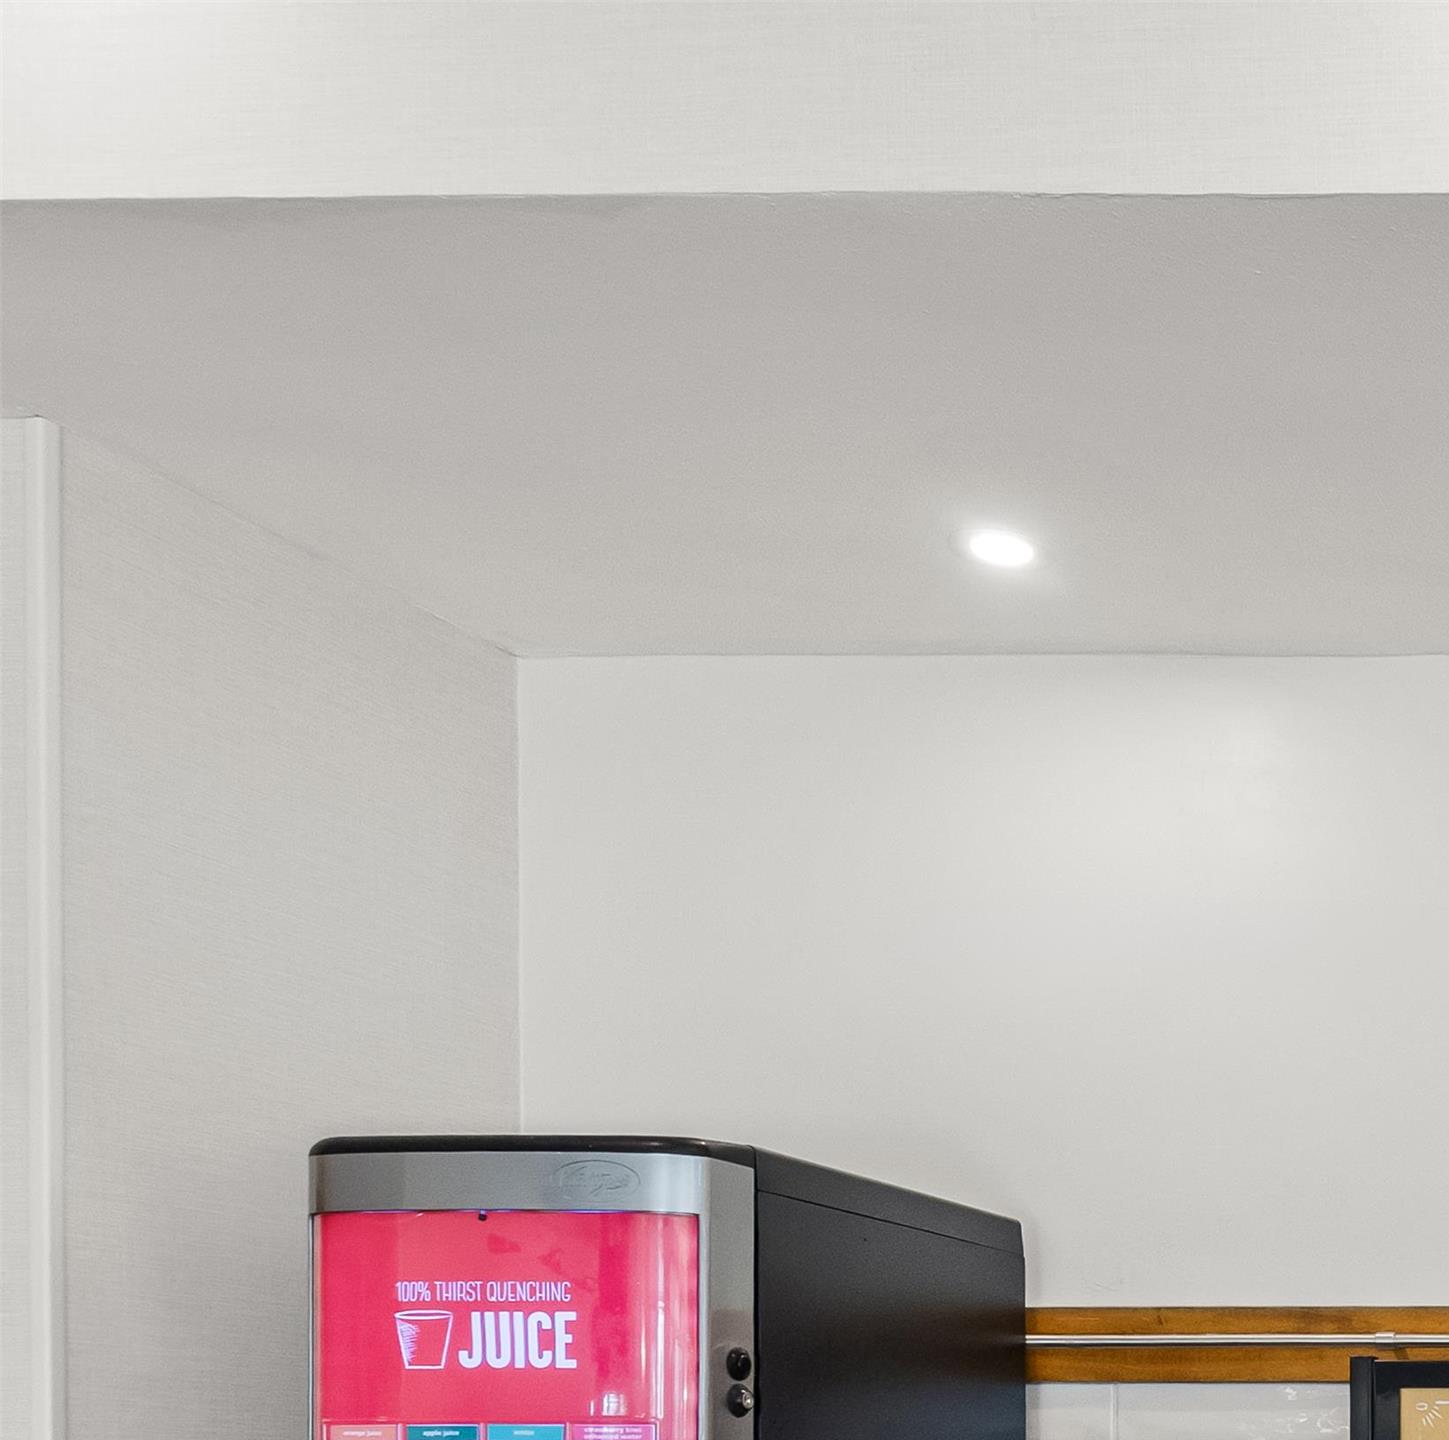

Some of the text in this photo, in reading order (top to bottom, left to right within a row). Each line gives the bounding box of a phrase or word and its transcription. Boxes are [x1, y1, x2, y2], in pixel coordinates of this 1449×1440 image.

[395, 1281, 572, 1302] 100% THIRST QUENCHING
[458, 1311, 577, 1369] JUICE
